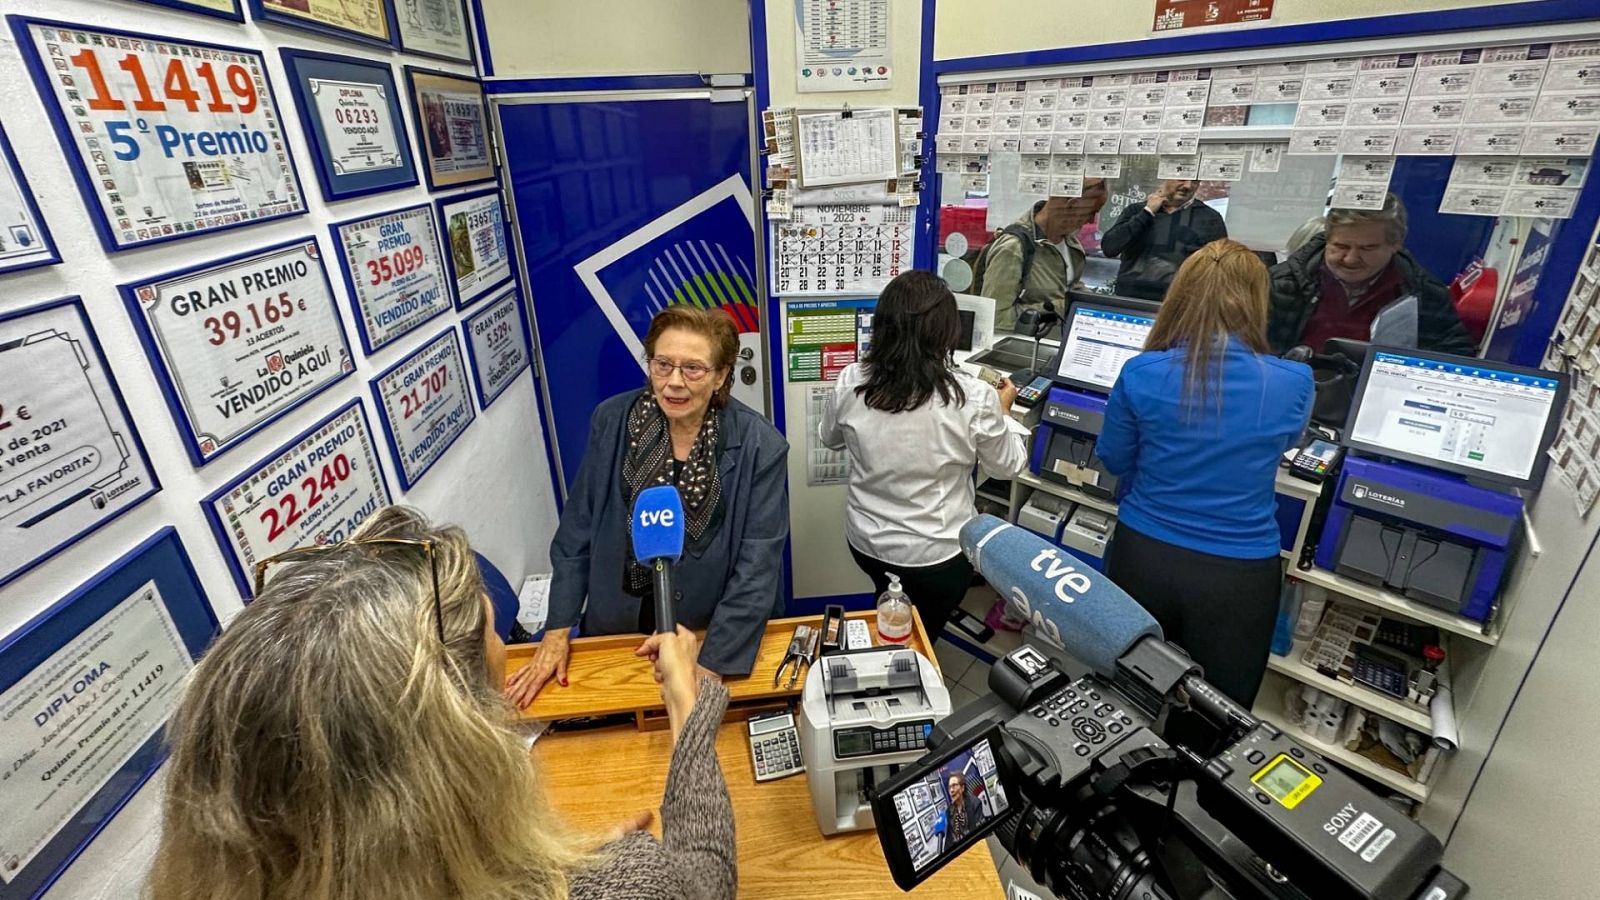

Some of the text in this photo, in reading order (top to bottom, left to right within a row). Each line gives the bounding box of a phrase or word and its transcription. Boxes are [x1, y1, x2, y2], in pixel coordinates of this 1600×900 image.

[70, 48, 257, 114] 11419
[335, 108, 379, 124] 06293
[104, 118, 268, 162] 5º Premio
[817, 204, 871, 213] NOVIEMBRE
[833, 214, 855, 223] 2023
[378, 232, 411, 253] PREMIO
[379, 221, 405, 238] GRAN
[782, 240, 900, 252] 6 7 8 9 10 11 12
[839, 228, 844, 238] 2
[858, 228, 862, 238] 3
[894, 227, 899, 237] 5
[366, 245, 424, 286] 35.099
[781, 253, 900, 265] 13 14 15 16 17 18 19
[781, 266, 899, 277] 20 21 22 23 24 25 26
[170, 279, 238, 316] GRAN
[241, 260, 308, 295] PREMIO
[781, 280, 844, 290] 27 28 29 30
[204, 291, 294, 346] 39.165
[298, 298, 307, 312] €
[374, 297, 418, 328] VENDIDO
[420, 282, 440, 306] AQUÍ
[475, 302, 514, 336] GRAN PREMIO
[255, 325, 286, 343] ACIERTOS
[487, 321, 508, 348] 5.529
[256, 366, 268, 378] La
[284, 343, 315, 366] Quiniela
[403, 367, 426, 388] GRAN
[425, 345, 452, 372] PREMIO
[488, 362, 510, 387] VENDIDO
[216, 372, 293, 419] VENDIDO
[297, 345, 331, 380] AQUÍ
[400, 365, 449, 420] 21.707
[17, 405, 31, 420] €
[8, 418, 68, 452] de 2021
[409, 425, 446, 464] VENDIDO
[447, 400, 465, 429] AQUÍ
[6, 443, 51, 469] venta
[267, 425, 355, 498] GRAN PREMIO
[27, 453, 95, 496] FAVORITA"
[106, 476, 140, 498] LOTERÍAS
[259, 453, 351, 543] 22.240
[350, 457, 359, 471] €
[346, 493, 378, 530] AQUÍ
[1368, 491, 1406, 506] LOTERÍAS
[300, 508, 323, 530] PLENO
[322, 502, 332, 513] AL
[640, 508, 674, 528] tve
[1030, 549, 1092, 604] tve
[34, 661, 111, 728] DIPLOMA
[40, 720, 76, 748] Jacinta
[41, 743, 77, 782] Quinto
[77, 714, 111, 750] Premio
[110, 706, 122, 719] al
[131, 663, 165, 701] 11419
[1323, 802, 1358, 836] SONY
